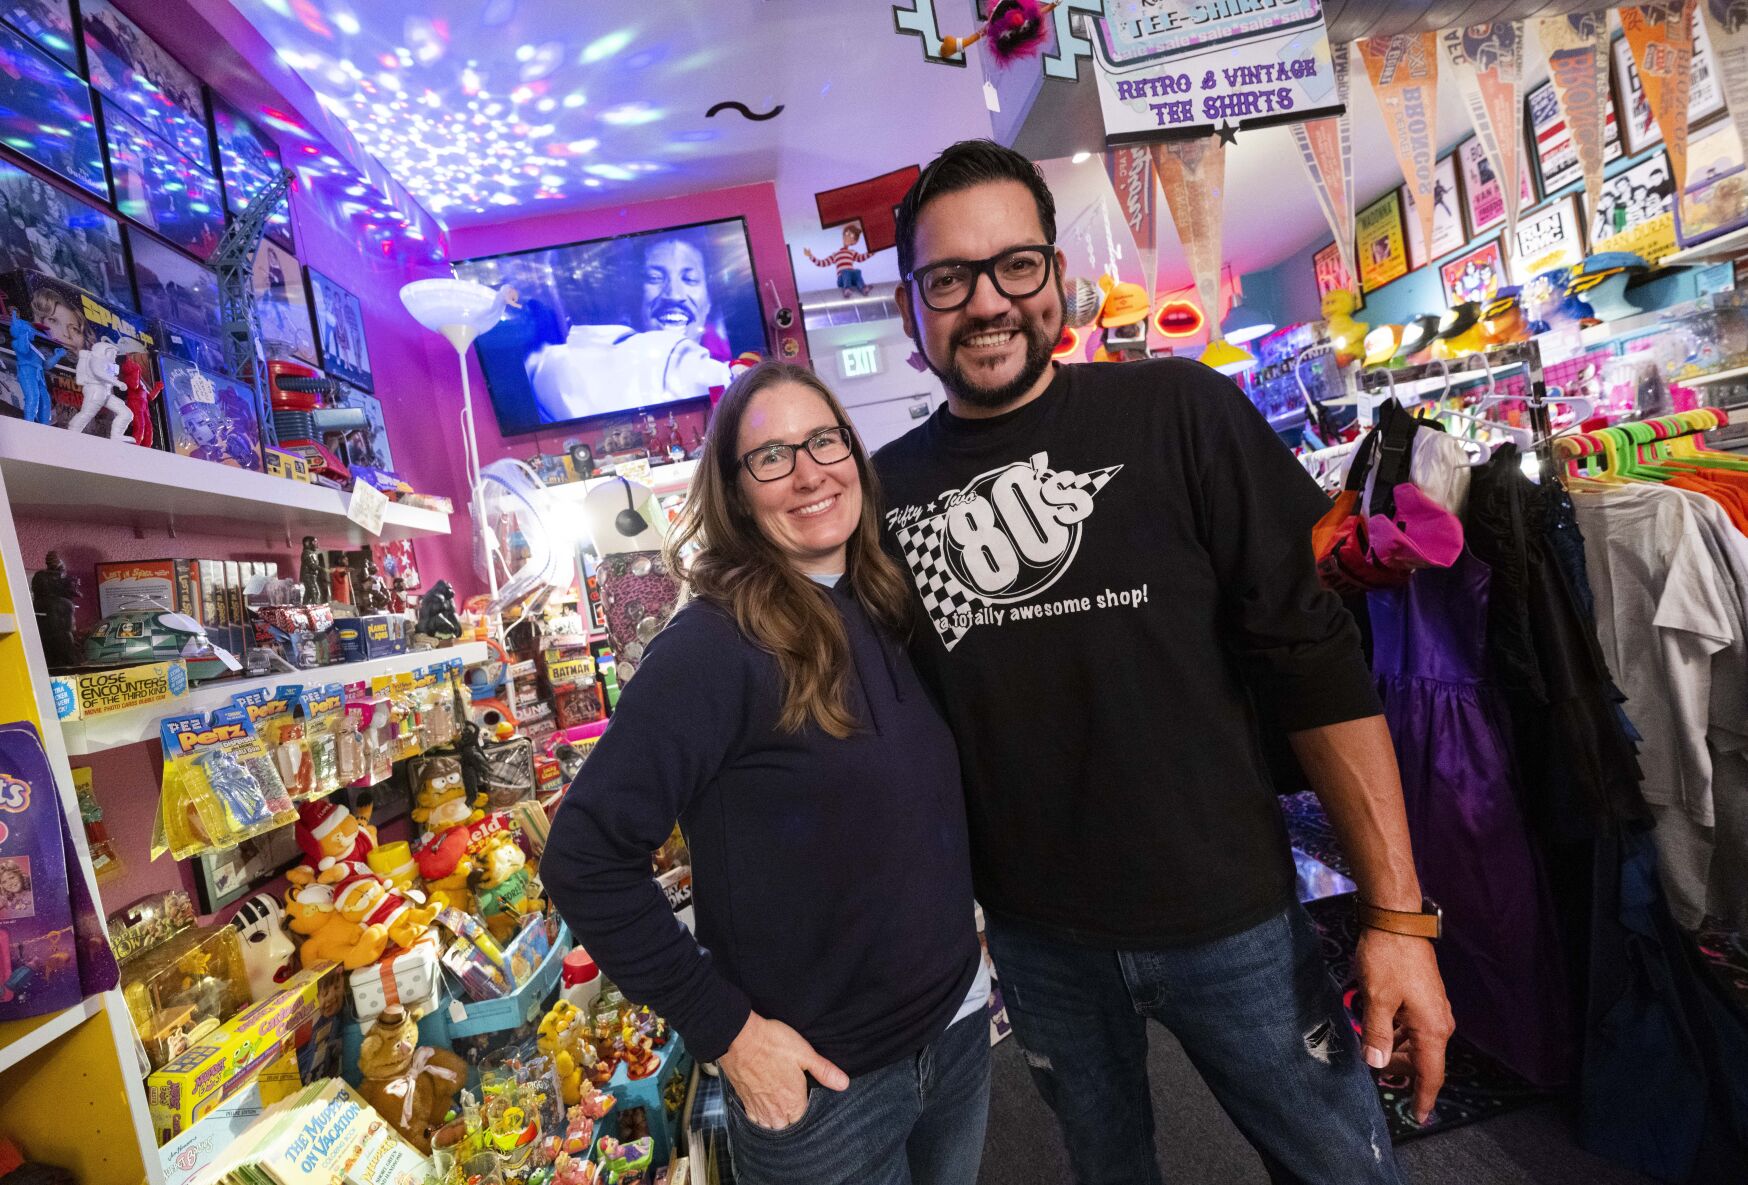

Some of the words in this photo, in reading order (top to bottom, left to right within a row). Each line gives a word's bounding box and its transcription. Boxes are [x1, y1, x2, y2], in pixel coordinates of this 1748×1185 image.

[1128, 0, 1301, 39] TEE-SHIR
[1199, 25, 1233, 42] sale
[1240, 16, 1274, 32] sale
[1280, 7, 1314, 22] sale
[1116, 73, 1192, 101] RETRO
[1200, 70, 1217, 90] &
[1222, 57, 1317, 87] VINTAGE
[1149, 98, 1195, 126] TEE
[1202, 87, 1294, 120] SHIRTS
[847, 351, 877, 372] EXIT
[885, 504, 924, 532] Fifty
[938, 488, 978, 510] Two
[947, 451, 1094, 594] 80's
[952, 606, 1005, 627] totally
[1010, 597, 1091, 621] awesome
[1096, 583, 1149, 609] shop!
[80, 672, 126, 689] CLOSE
[552, 664, 590, 679] BATMAN
[81, 676, 167, 700] ENCOUNTERS
[83, 699, 98, 708] OF
[101, 695, 120, 706] THE
[122, 690, 148, 702] THIRD
[148, 686, 167, 697] KIND
[236, 692, 262, 708] PEZ
[300, 690, 321, 702] PEZ
[103, 704, 121, 712] PHOTO
[121, 701, 138, 709] CARDS
[167, 719, 202, 733] PEZ
[285, 1134, 309, 1163] THE
[303, 1088, 350, 1142] MUPPETS
[301, 1150, 319, 1173] ON
[311, 1103, 361, 1157] VACATION
